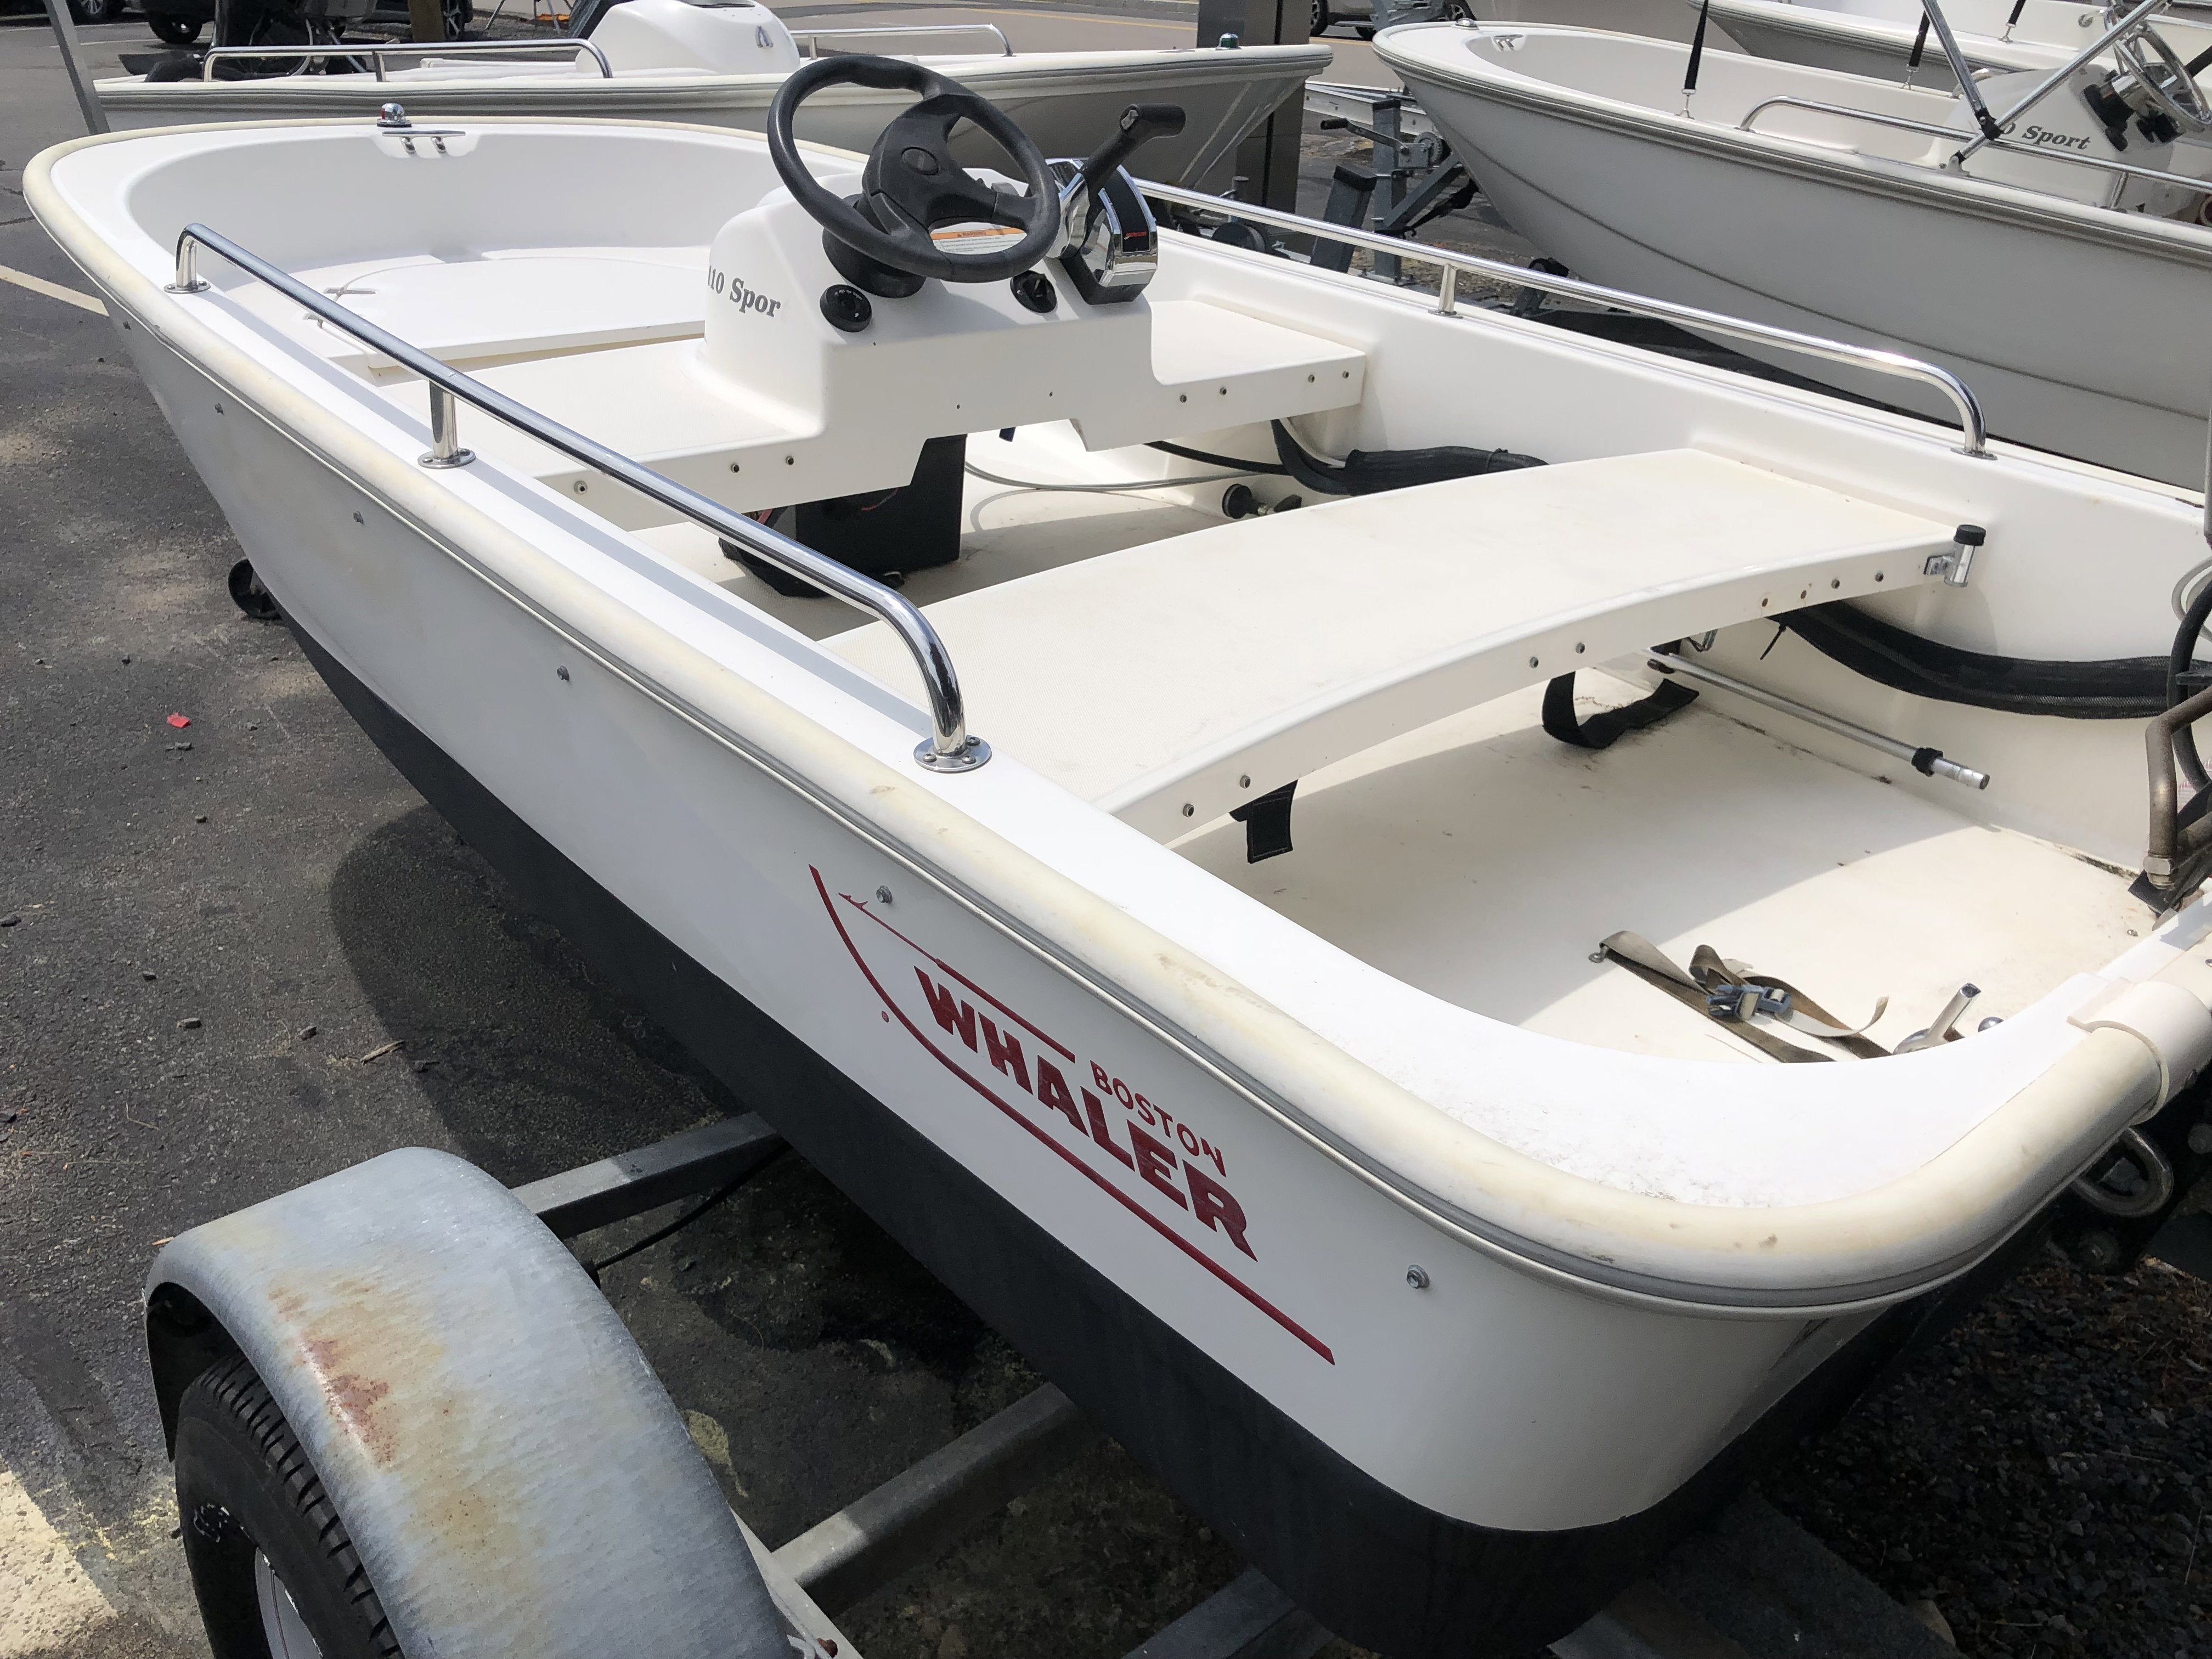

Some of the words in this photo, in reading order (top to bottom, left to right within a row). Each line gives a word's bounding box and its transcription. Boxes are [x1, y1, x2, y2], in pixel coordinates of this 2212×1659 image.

[2022, 125, 2091, 150] Sport
[913, 965, 1259, 1263] WHALER
[1090, 1059, 1227, 1178] BOSTON
